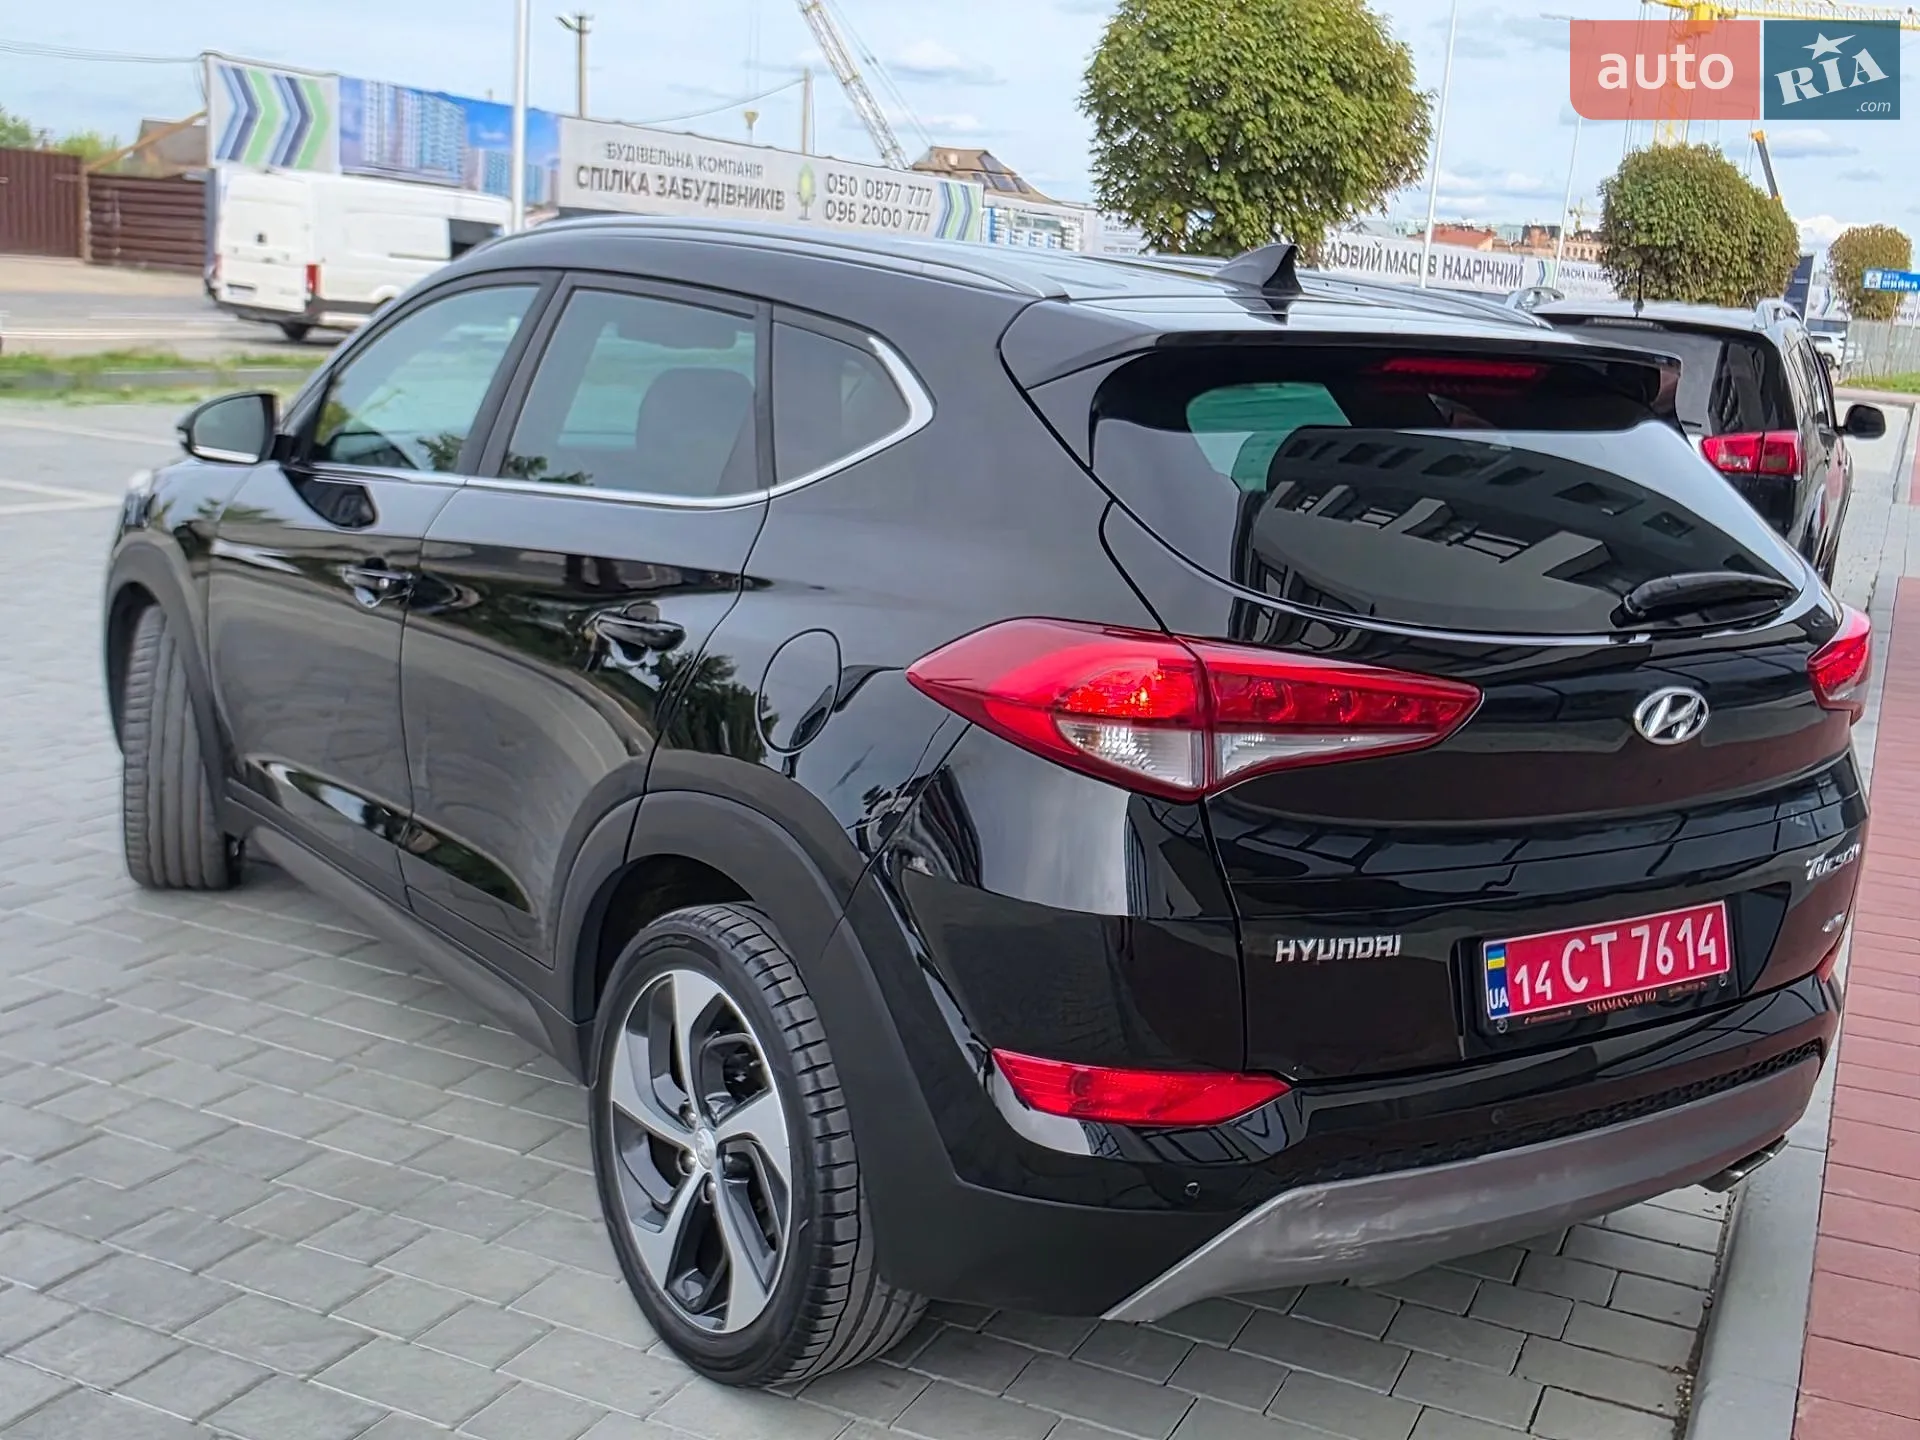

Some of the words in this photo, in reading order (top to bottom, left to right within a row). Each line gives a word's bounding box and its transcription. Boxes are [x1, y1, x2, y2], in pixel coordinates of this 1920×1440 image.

[606, 142, 694, 171] БУДІВЕЛЬНА
[699, 155, 764, 179] КОМПАНІЯ
[576, 165, 650, 197] СПІЛКА
[655, 174, 786, 211] ЗАБУДІВНИКІВ
[827, 173, 858, 197] 050
[864, 178, 902, 203] 0877
[907, 184, 933, 207] 777
[825, 199, 857, 223] 096
[861, 205, 902, 229] 2000
[907, 210, 932, 232] 777
[1326, 240, 1383, 273] ЛОВИЙ
[1385, 248, 1438, 277] МАСІВ
[1442, 252, 1526, 289] НАДРІЧНИЙ
[1275, 934, 1401, 963] HYUNDAI
[1513, 960, 1553, 1006] 14
[1561, 931, 1618, 994] CT
[1630, 912, 1718, 982] 7614
[1487, 987, 1510, 1010] UA
